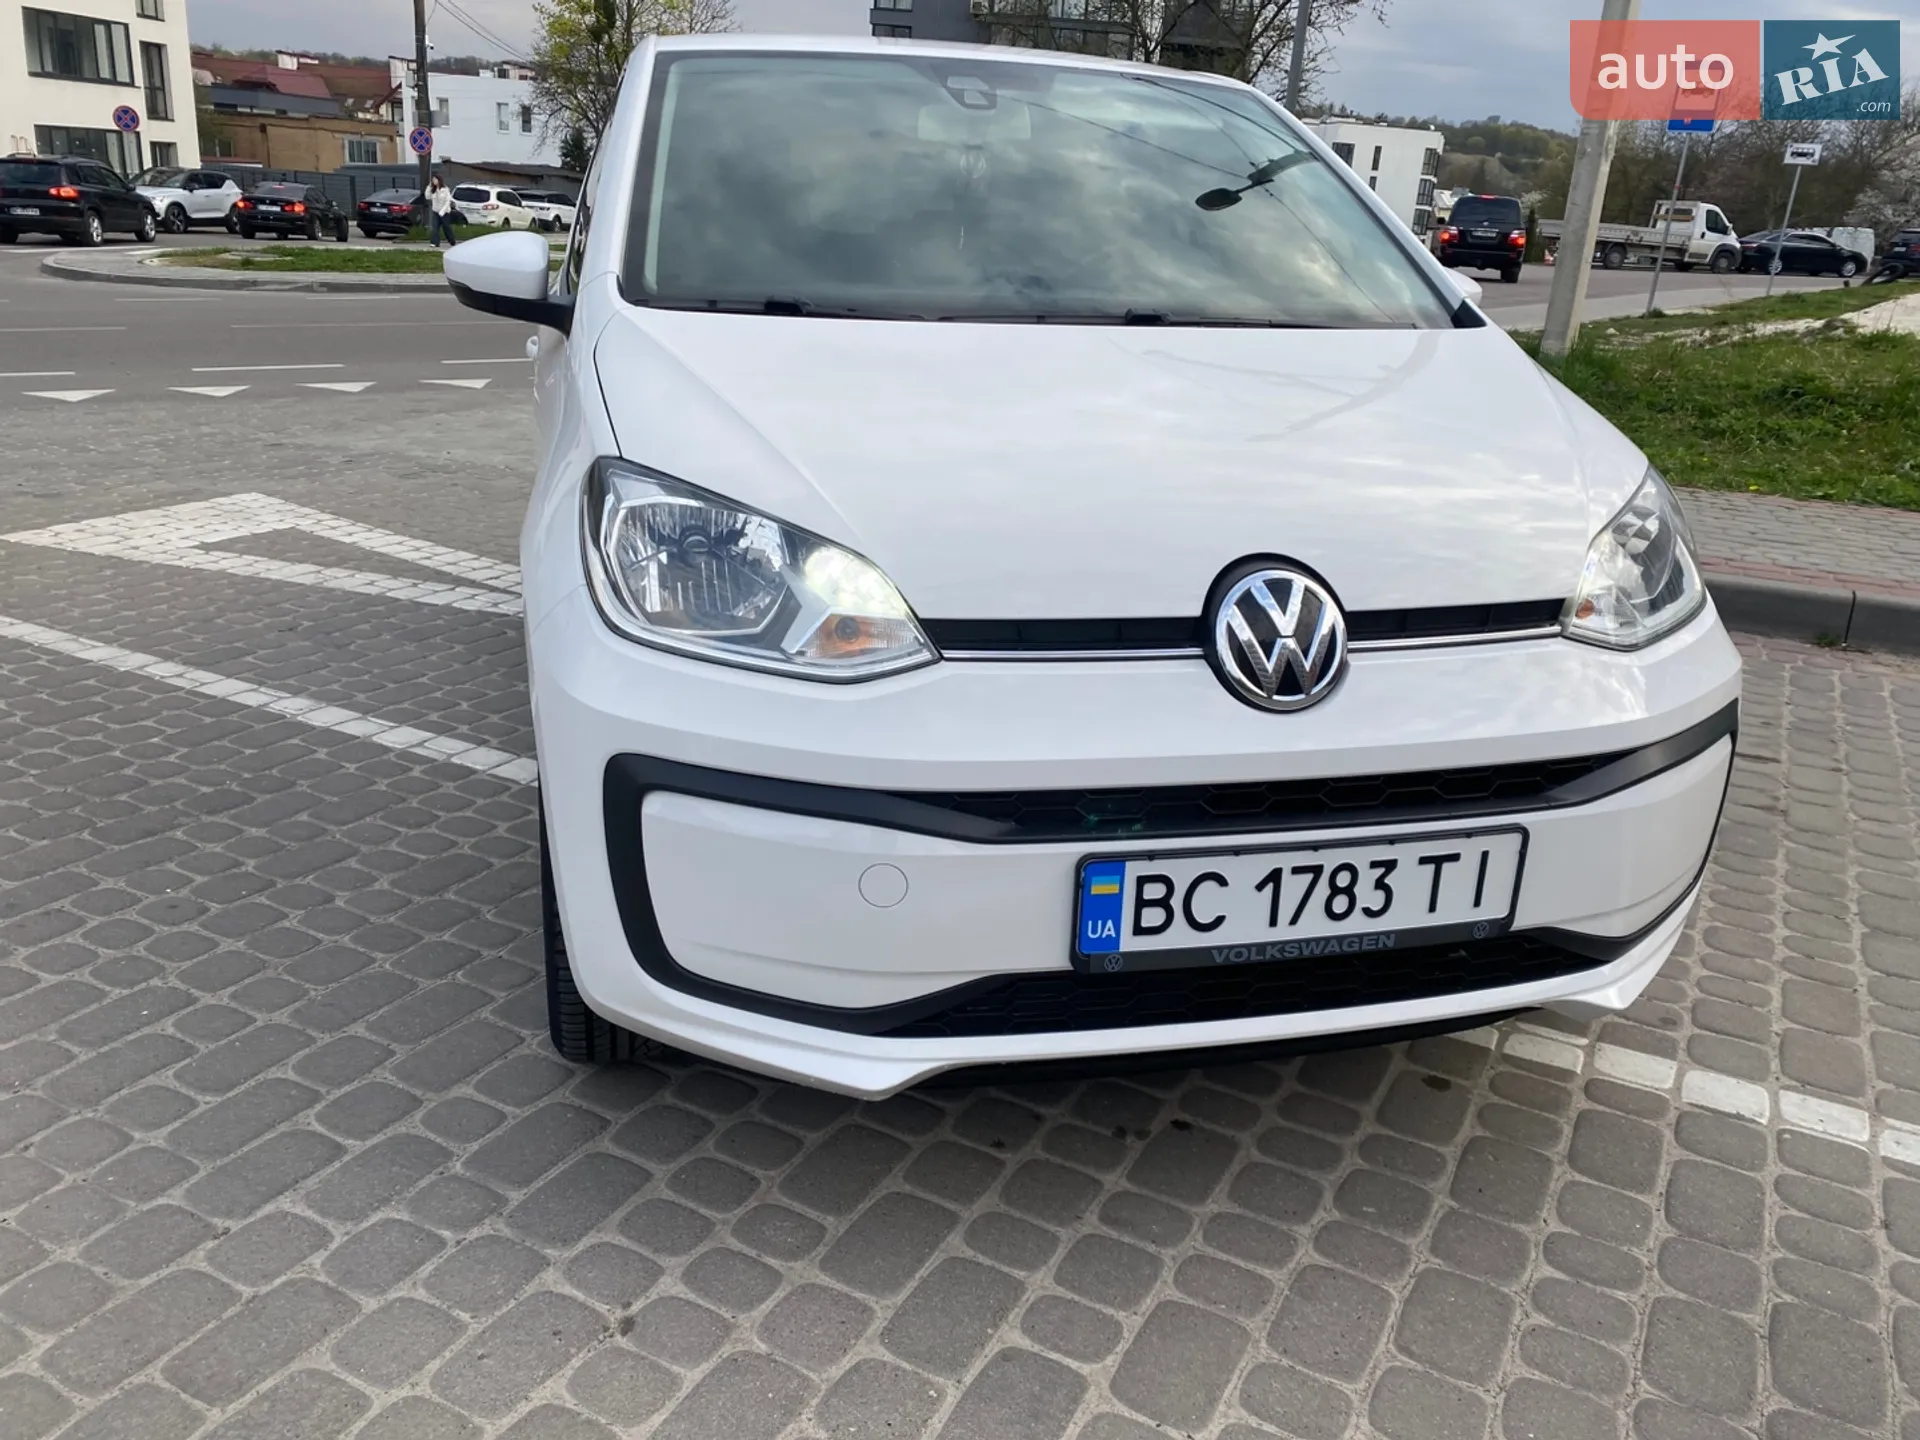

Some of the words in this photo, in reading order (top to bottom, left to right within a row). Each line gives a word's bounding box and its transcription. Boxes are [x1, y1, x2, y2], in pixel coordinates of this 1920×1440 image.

[1132, 871, 1229, 937] BC
[1254, 858, 1399, 928] 1783
[1417, 849, 1490, 914] TI
[1087, 920, 1116, 939] UA
[1211, 934, 1396, 965] VOLKSWAGEN
